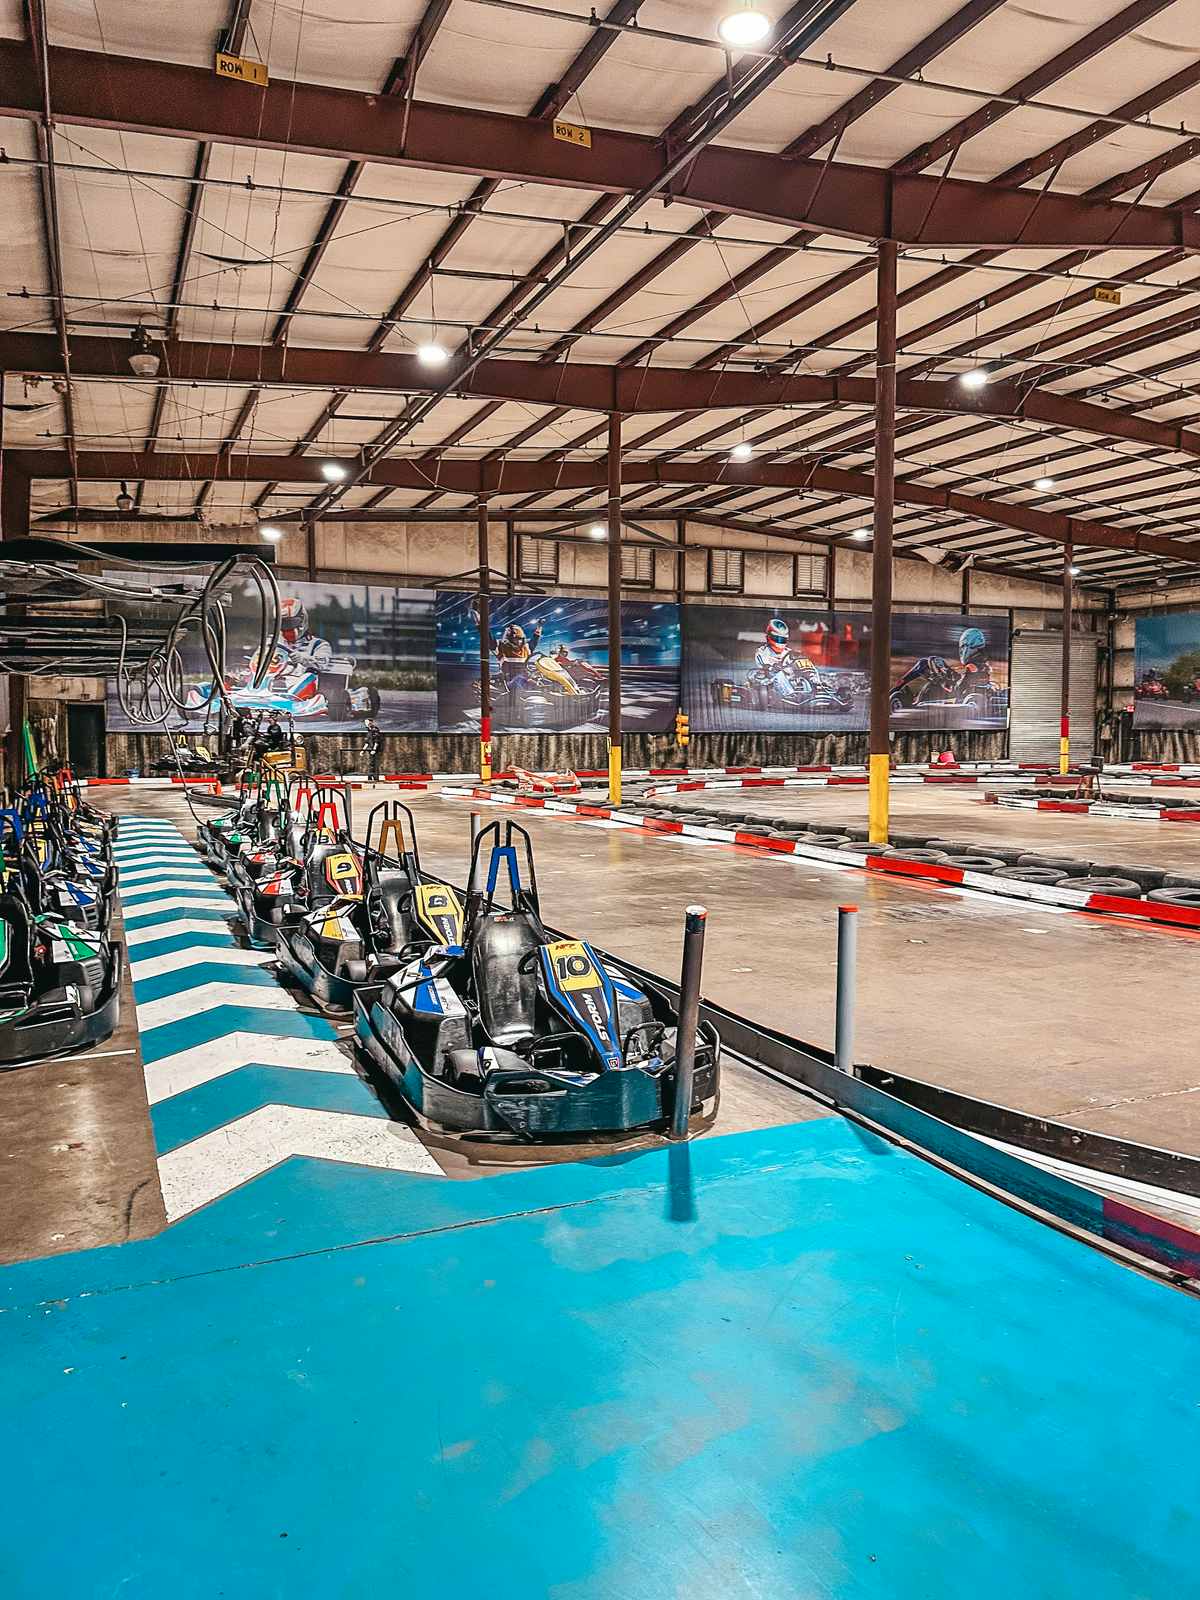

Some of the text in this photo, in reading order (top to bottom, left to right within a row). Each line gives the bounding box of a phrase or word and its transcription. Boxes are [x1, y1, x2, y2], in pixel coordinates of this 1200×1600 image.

[220, 60, 243, 75] ROW
[556, 125, 585, 142] ROW 2
[556, 955, 592, 980] 10
[581, 993, 611, 1042] STORM
